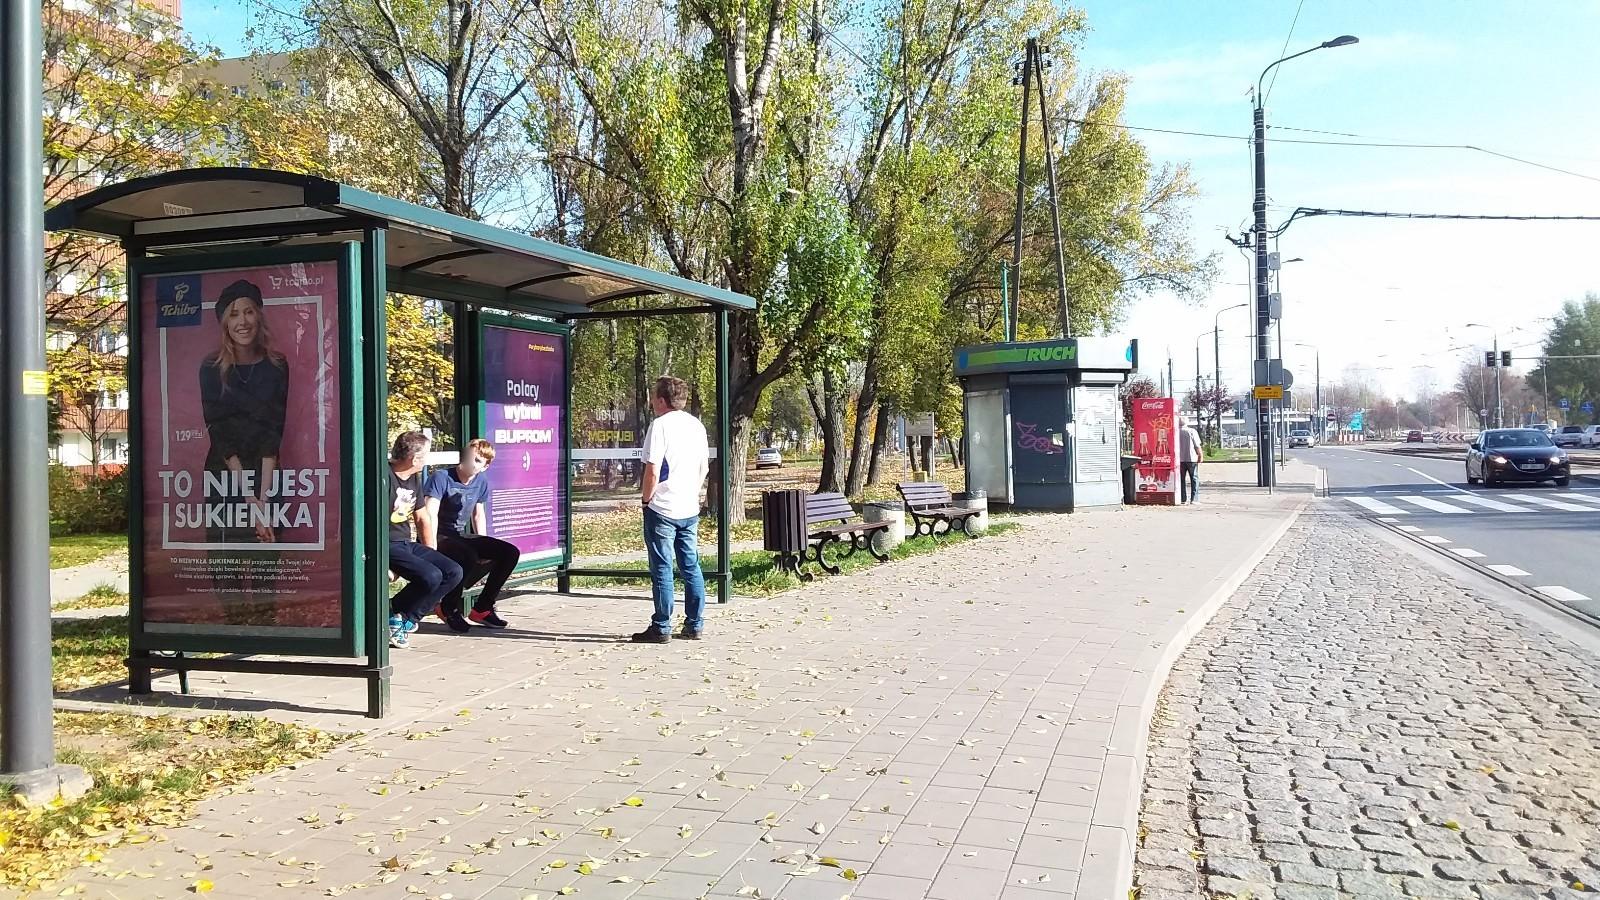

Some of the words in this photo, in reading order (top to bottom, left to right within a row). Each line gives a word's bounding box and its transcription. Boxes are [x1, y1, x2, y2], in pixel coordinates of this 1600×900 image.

[161, 304, 200, 317] Tchibo
[1027, 346, 1076, 362] RUCH
[507, 379, 540, 401] Polacy
[504, 402, 542, 424] wybrali
[175, 430, 191, 442] 129
[494, 429, 552, 444] IBUPROM
[158, 470, 193, 498] TO
[203, 469, 256, 497] NIE
[265, 468, 330, 498] JEST
[174, 502, 314, 529] SUKIENKA
